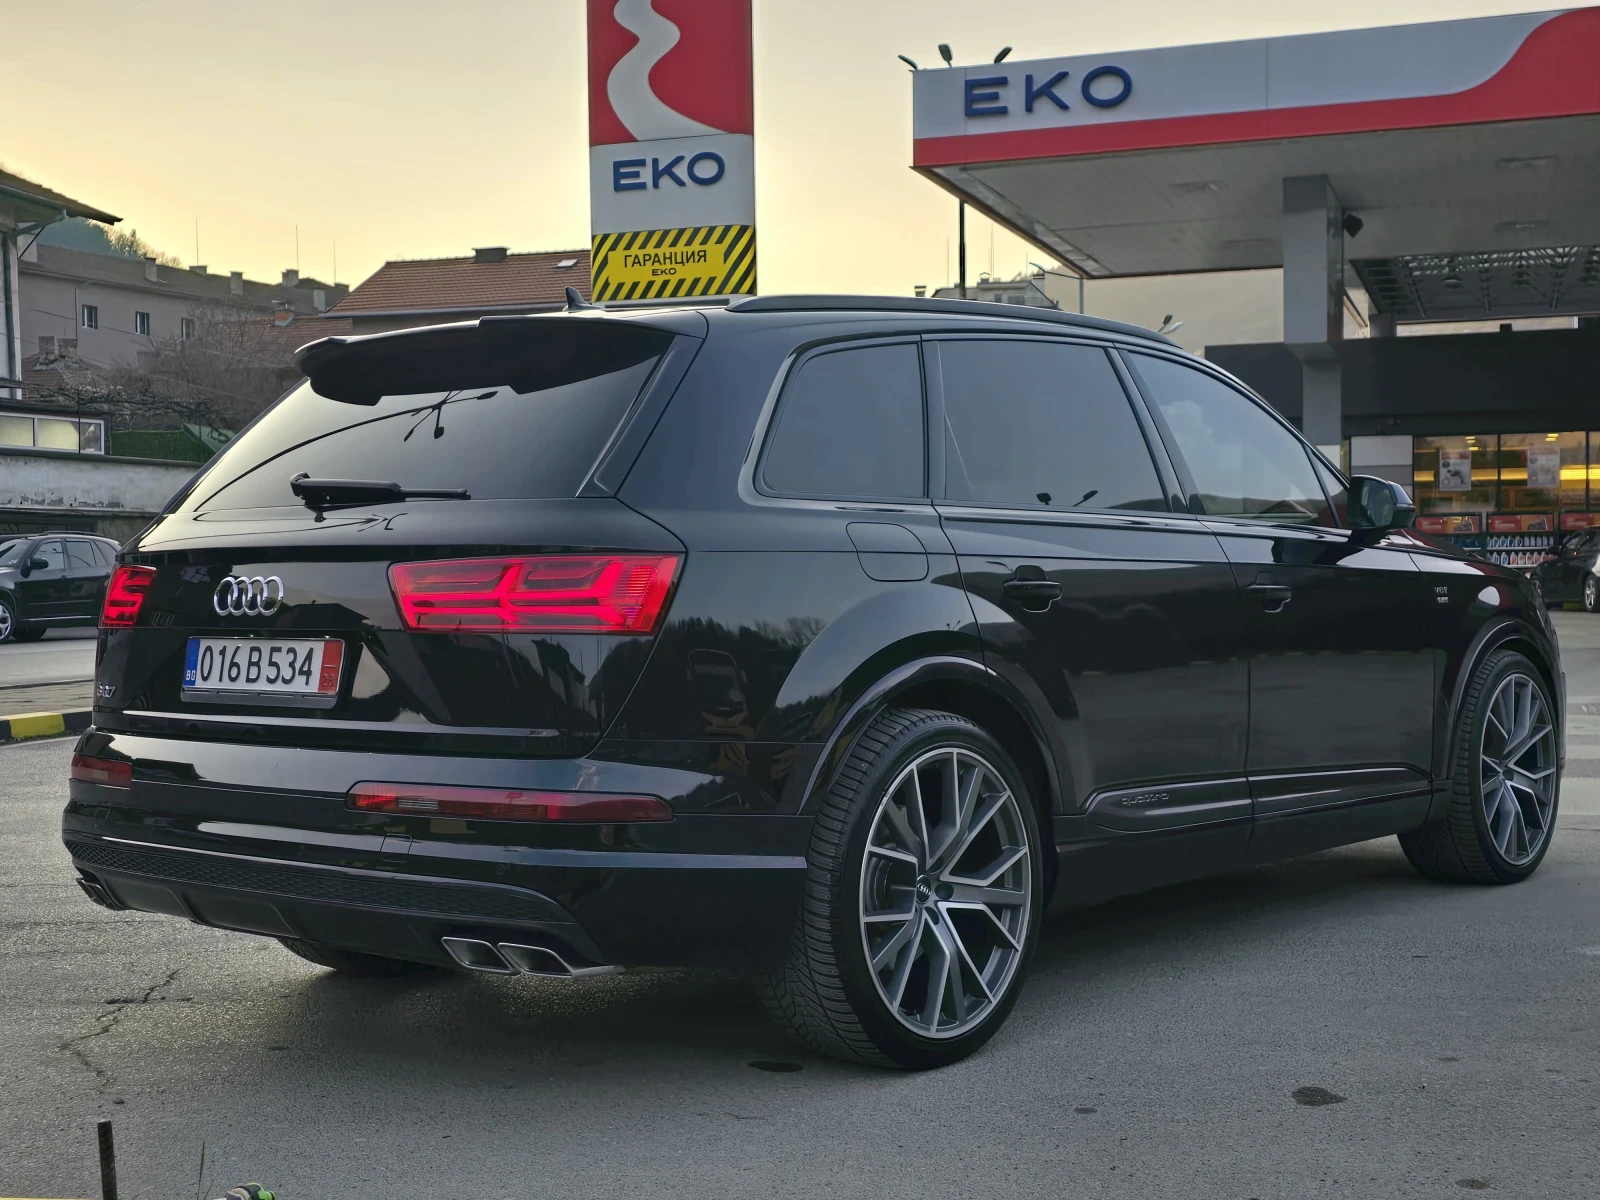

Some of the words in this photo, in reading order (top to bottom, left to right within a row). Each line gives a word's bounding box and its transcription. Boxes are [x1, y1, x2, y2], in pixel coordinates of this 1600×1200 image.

[964, 65, 1133, 116] EKO
[612, 151, 726, 193] EKO
[623, 249, 707, 268] ГАРАНЦИЯ
[651, 267, 677, 276] EKO
[185, 669, 196, 681] BG
[200, 645, 315, 686] 016B534
